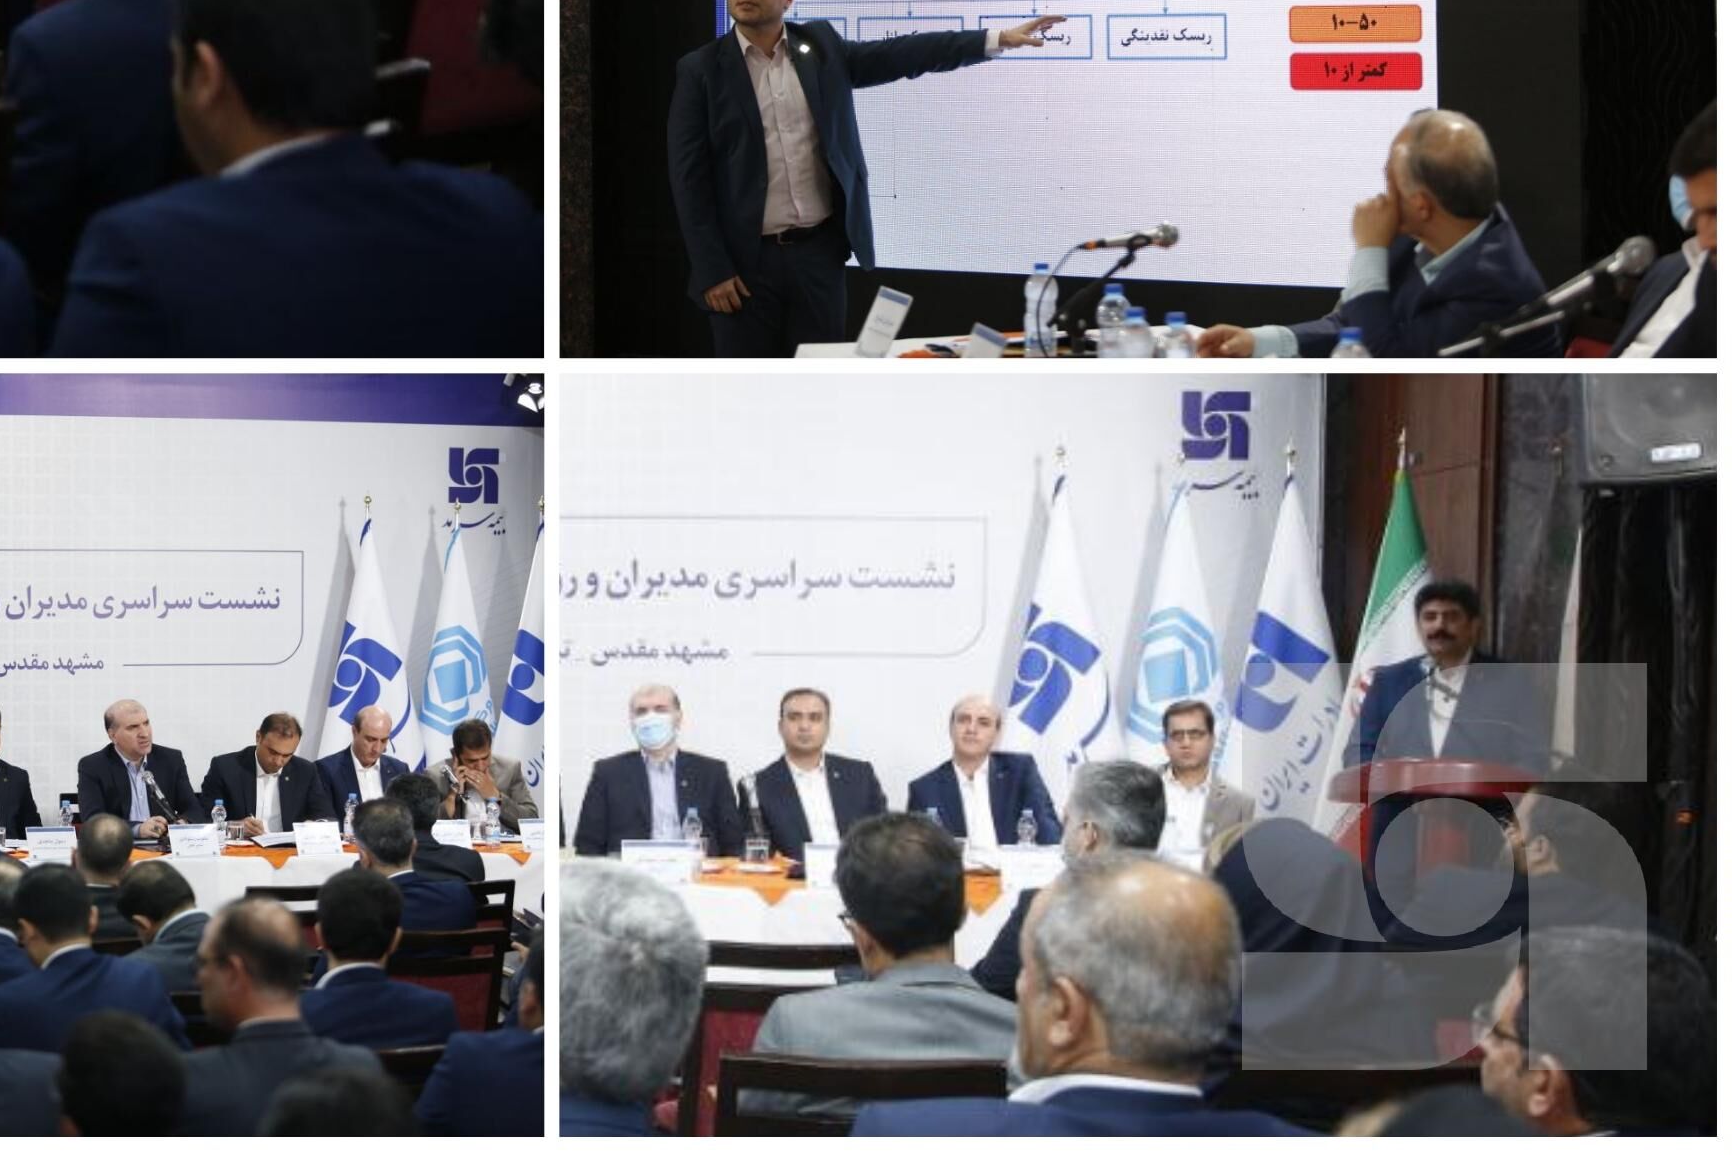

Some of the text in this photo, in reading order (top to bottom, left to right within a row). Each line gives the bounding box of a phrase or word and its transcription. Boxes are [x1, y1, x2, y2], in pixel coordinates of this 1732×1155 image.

[1120, 27, 1213, 47] ریسک نقدینگی
[1341, 61, 1355, 83] از
[1357, 61, 1388, 83] کمتر
[584, 574, 600, 600] و
[604, 558, 709, 600] مدیران
[713, 557, 842, 599] سراسری
[847, 559, 957, 590] نشست
[4, 585, 88, 621] مدیران
[92, 585, 193, 619] سراسری
[197, 586, 281, 610] نشست
[52, 652, 105, 676] مشهد
[589, 639, 659, 666] مقدس
[666, 640, 730, 665] مشهد
